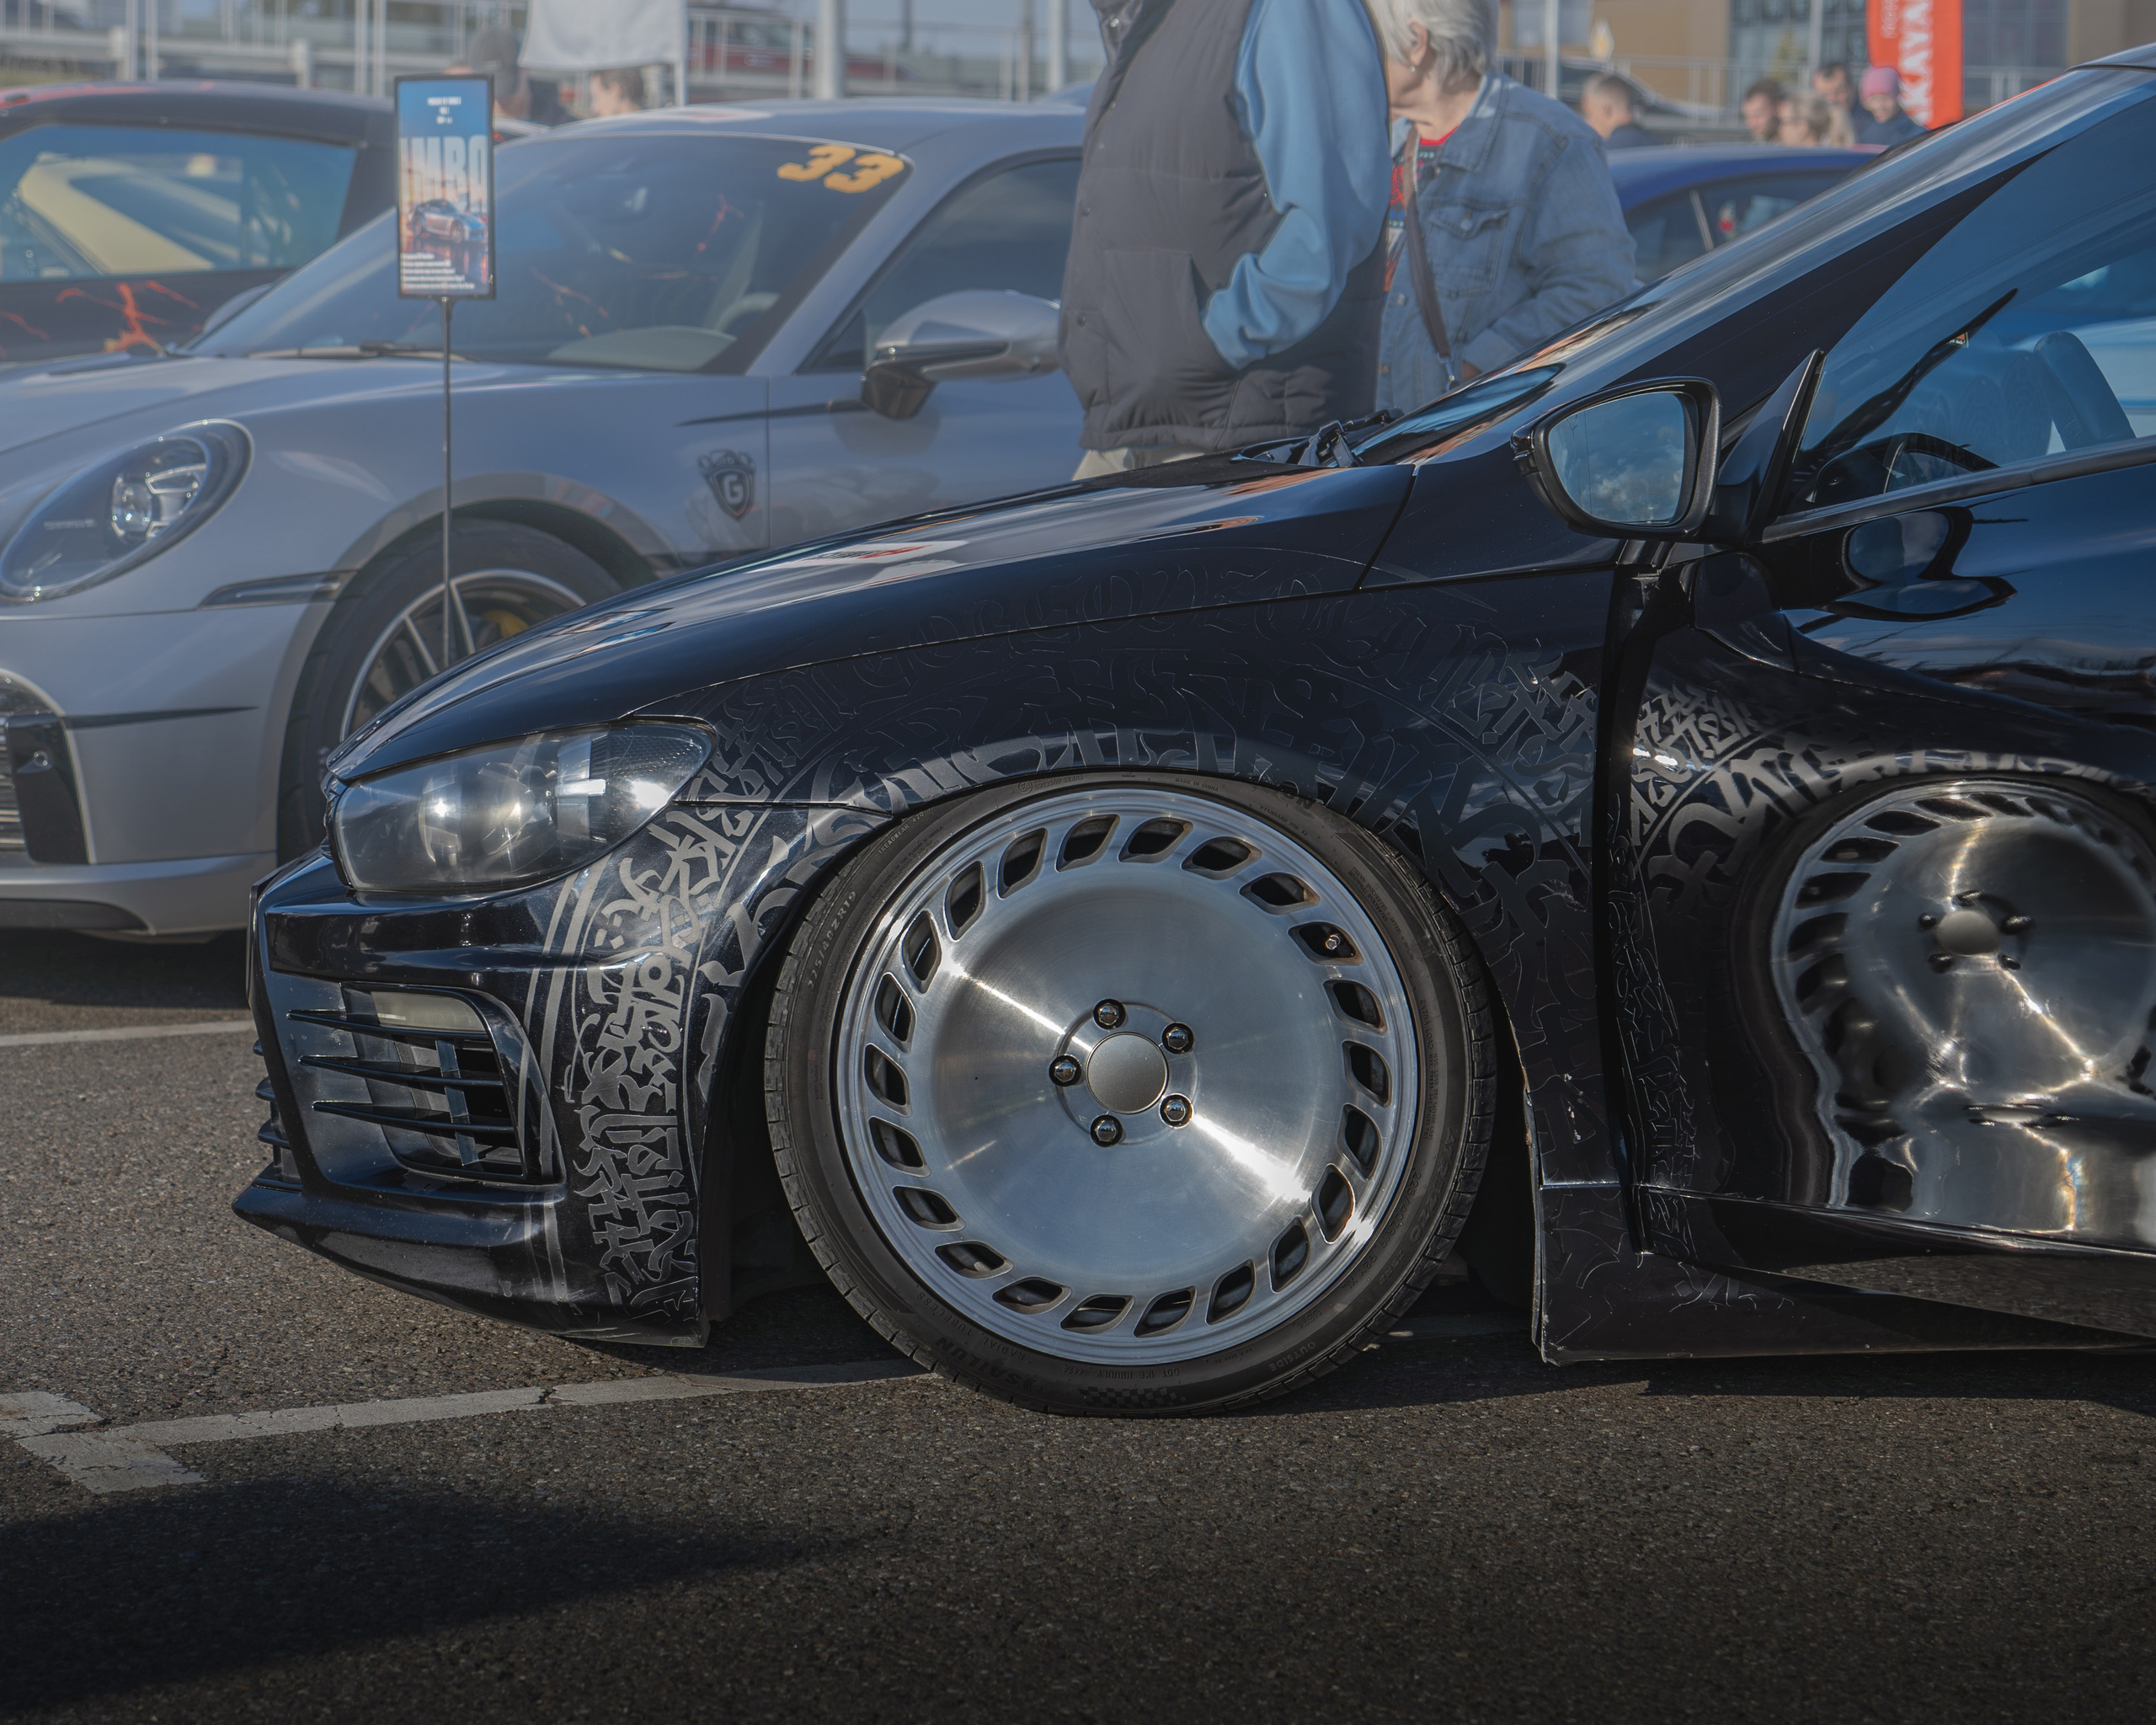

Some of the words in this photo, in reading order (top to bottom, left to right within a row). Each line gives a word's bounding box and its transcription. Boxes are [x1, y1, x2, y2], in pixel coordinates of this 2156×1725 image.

[776, 144, 905, 194] 33
[723, 474, 744, 504] G
[1172, 777, 1191, 785] MADE
[1199, 782, 1219, 793] CHINA
[876, 822, 911, 856] TREADWEAR
[910, 810, 926, 825] 420
[1258, 804, 1289, 824] STANDARD
[805, 889, 860, 991] 225/40ZR19
[1417, 998, 1431, 1026] EXTRA
[1424, 1027, 1434, 1049] LOAD
[1406, 1125, 1457, 1245] ATREZZO
[1376, 1169, 1422, 1250] 225/40ZR19
[1339, 1274, 1358, 1294] XL
[915, 1289, 974, 1337] TUBELESS
[933, 1332, 1022, 1387] SAILUN
[979, 1333, 1026, 1362] RADIAL
[1267, 1338, 1317, 1373] OUTSIDE
[1138, 1369, 1155, 1380] 1KE
[1160, 1365, 1181, 1378] DOT
